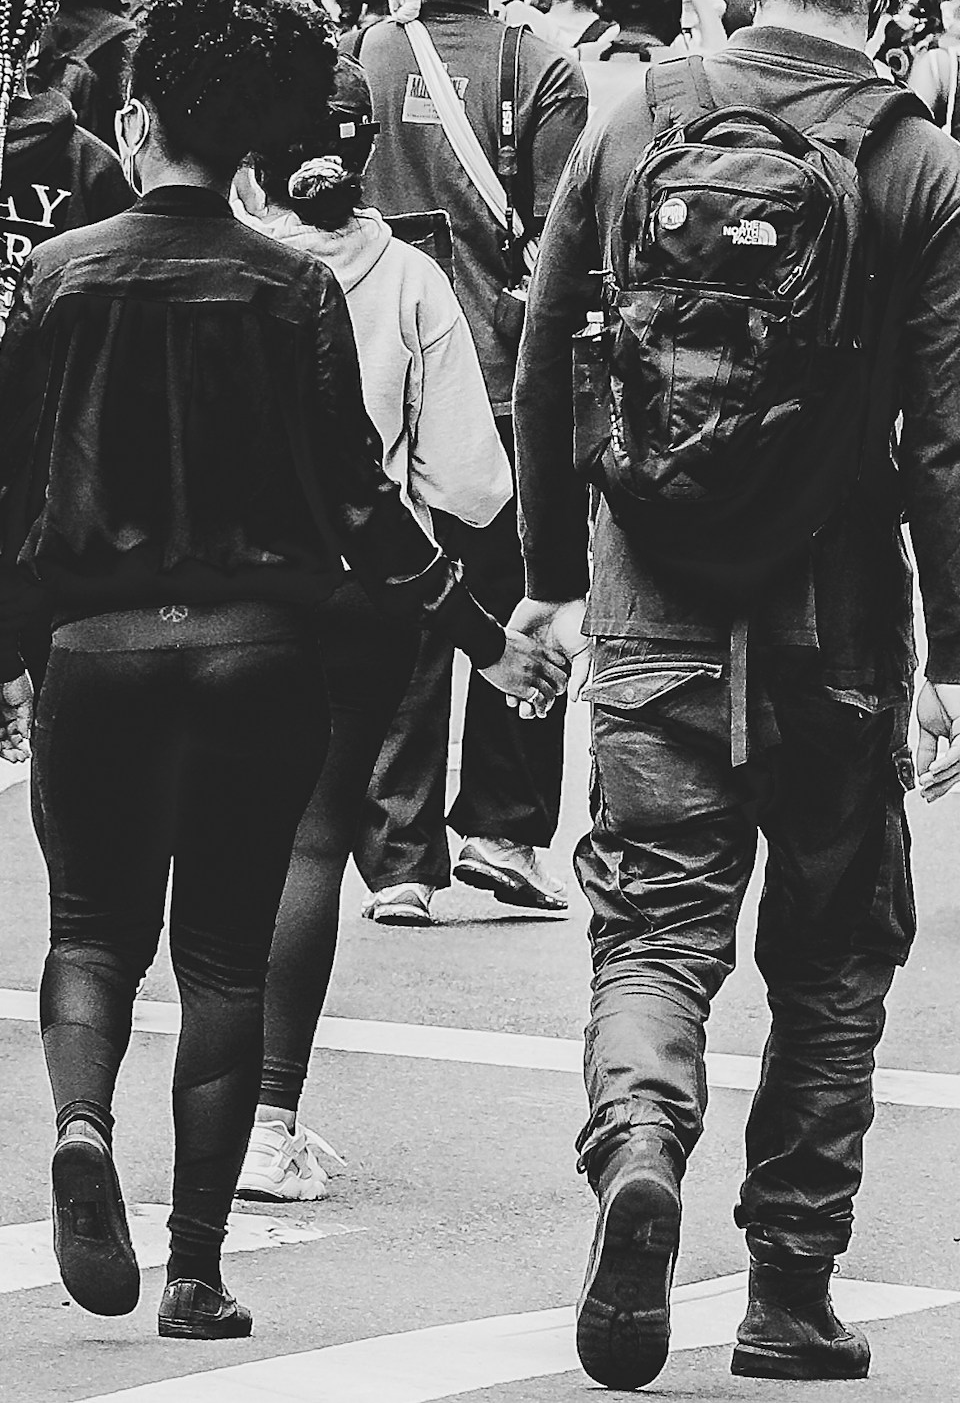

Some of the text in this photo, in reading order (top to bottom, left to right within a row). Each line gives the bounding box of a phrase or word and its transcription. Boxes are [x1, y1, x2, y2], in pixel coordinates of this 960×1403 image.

[740, 218, 759, 228] THE
[723, 226, 759, 236] NORTH
[732, 235, 759, 245] FACE
